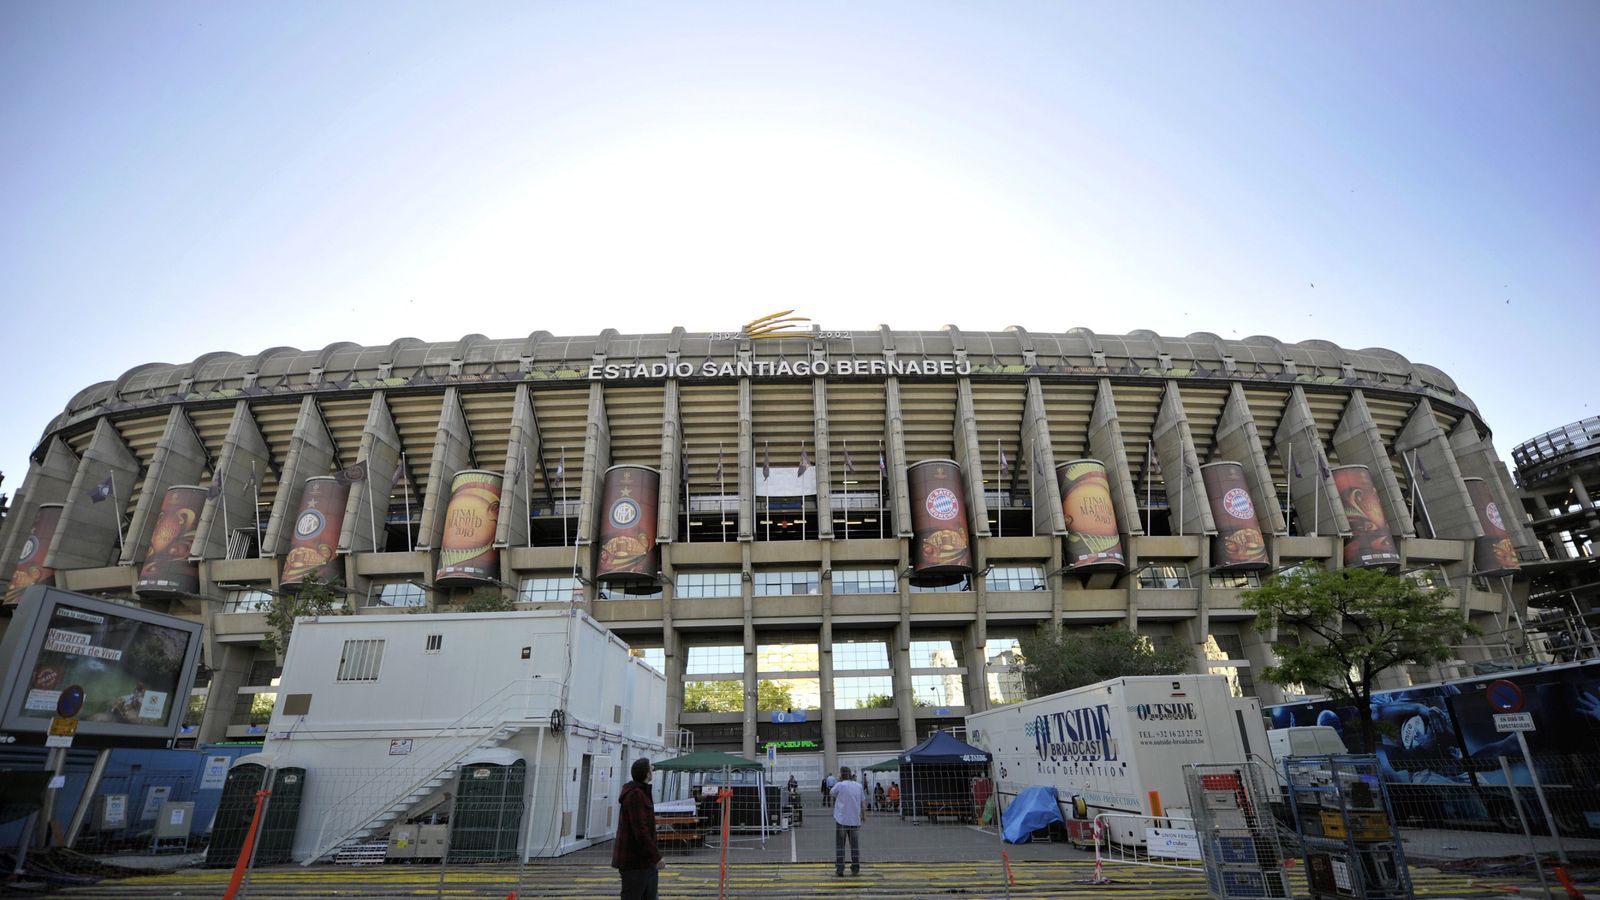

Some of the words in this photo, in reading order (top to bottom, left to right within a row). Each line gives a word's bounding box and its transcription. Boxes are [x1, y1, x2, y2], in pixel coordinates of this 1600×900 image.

[818, 331, 851, 339] 2002
[588, 362, 694, 379] ESTADIO
[702, 360, 830, 377] SANTIAGO
[837, 360, 971, 376] BERNABEU
[453, 509, 475, 518] FINAL
[448, 516, 482, 528] MADRID
[455, 528, 474, 537] 2010
[45, 640, 86, 655] Maneras
[88, 645, 100, 656] de
[1137, 703, 1197, 721] OUTSIDE
[1035, 704, 1118, 762] OUTSIDE
[1138, 731, 1156, 739] TEL.
[1157, 730, 1168, 738] +32
[1169, 730, 1177, 738] 16
[1195, 729, 1202, 737] 52
[1050, 740, 1101, 756] BROADCAST
[1063, 766, 1125, 777] DEFINITION
